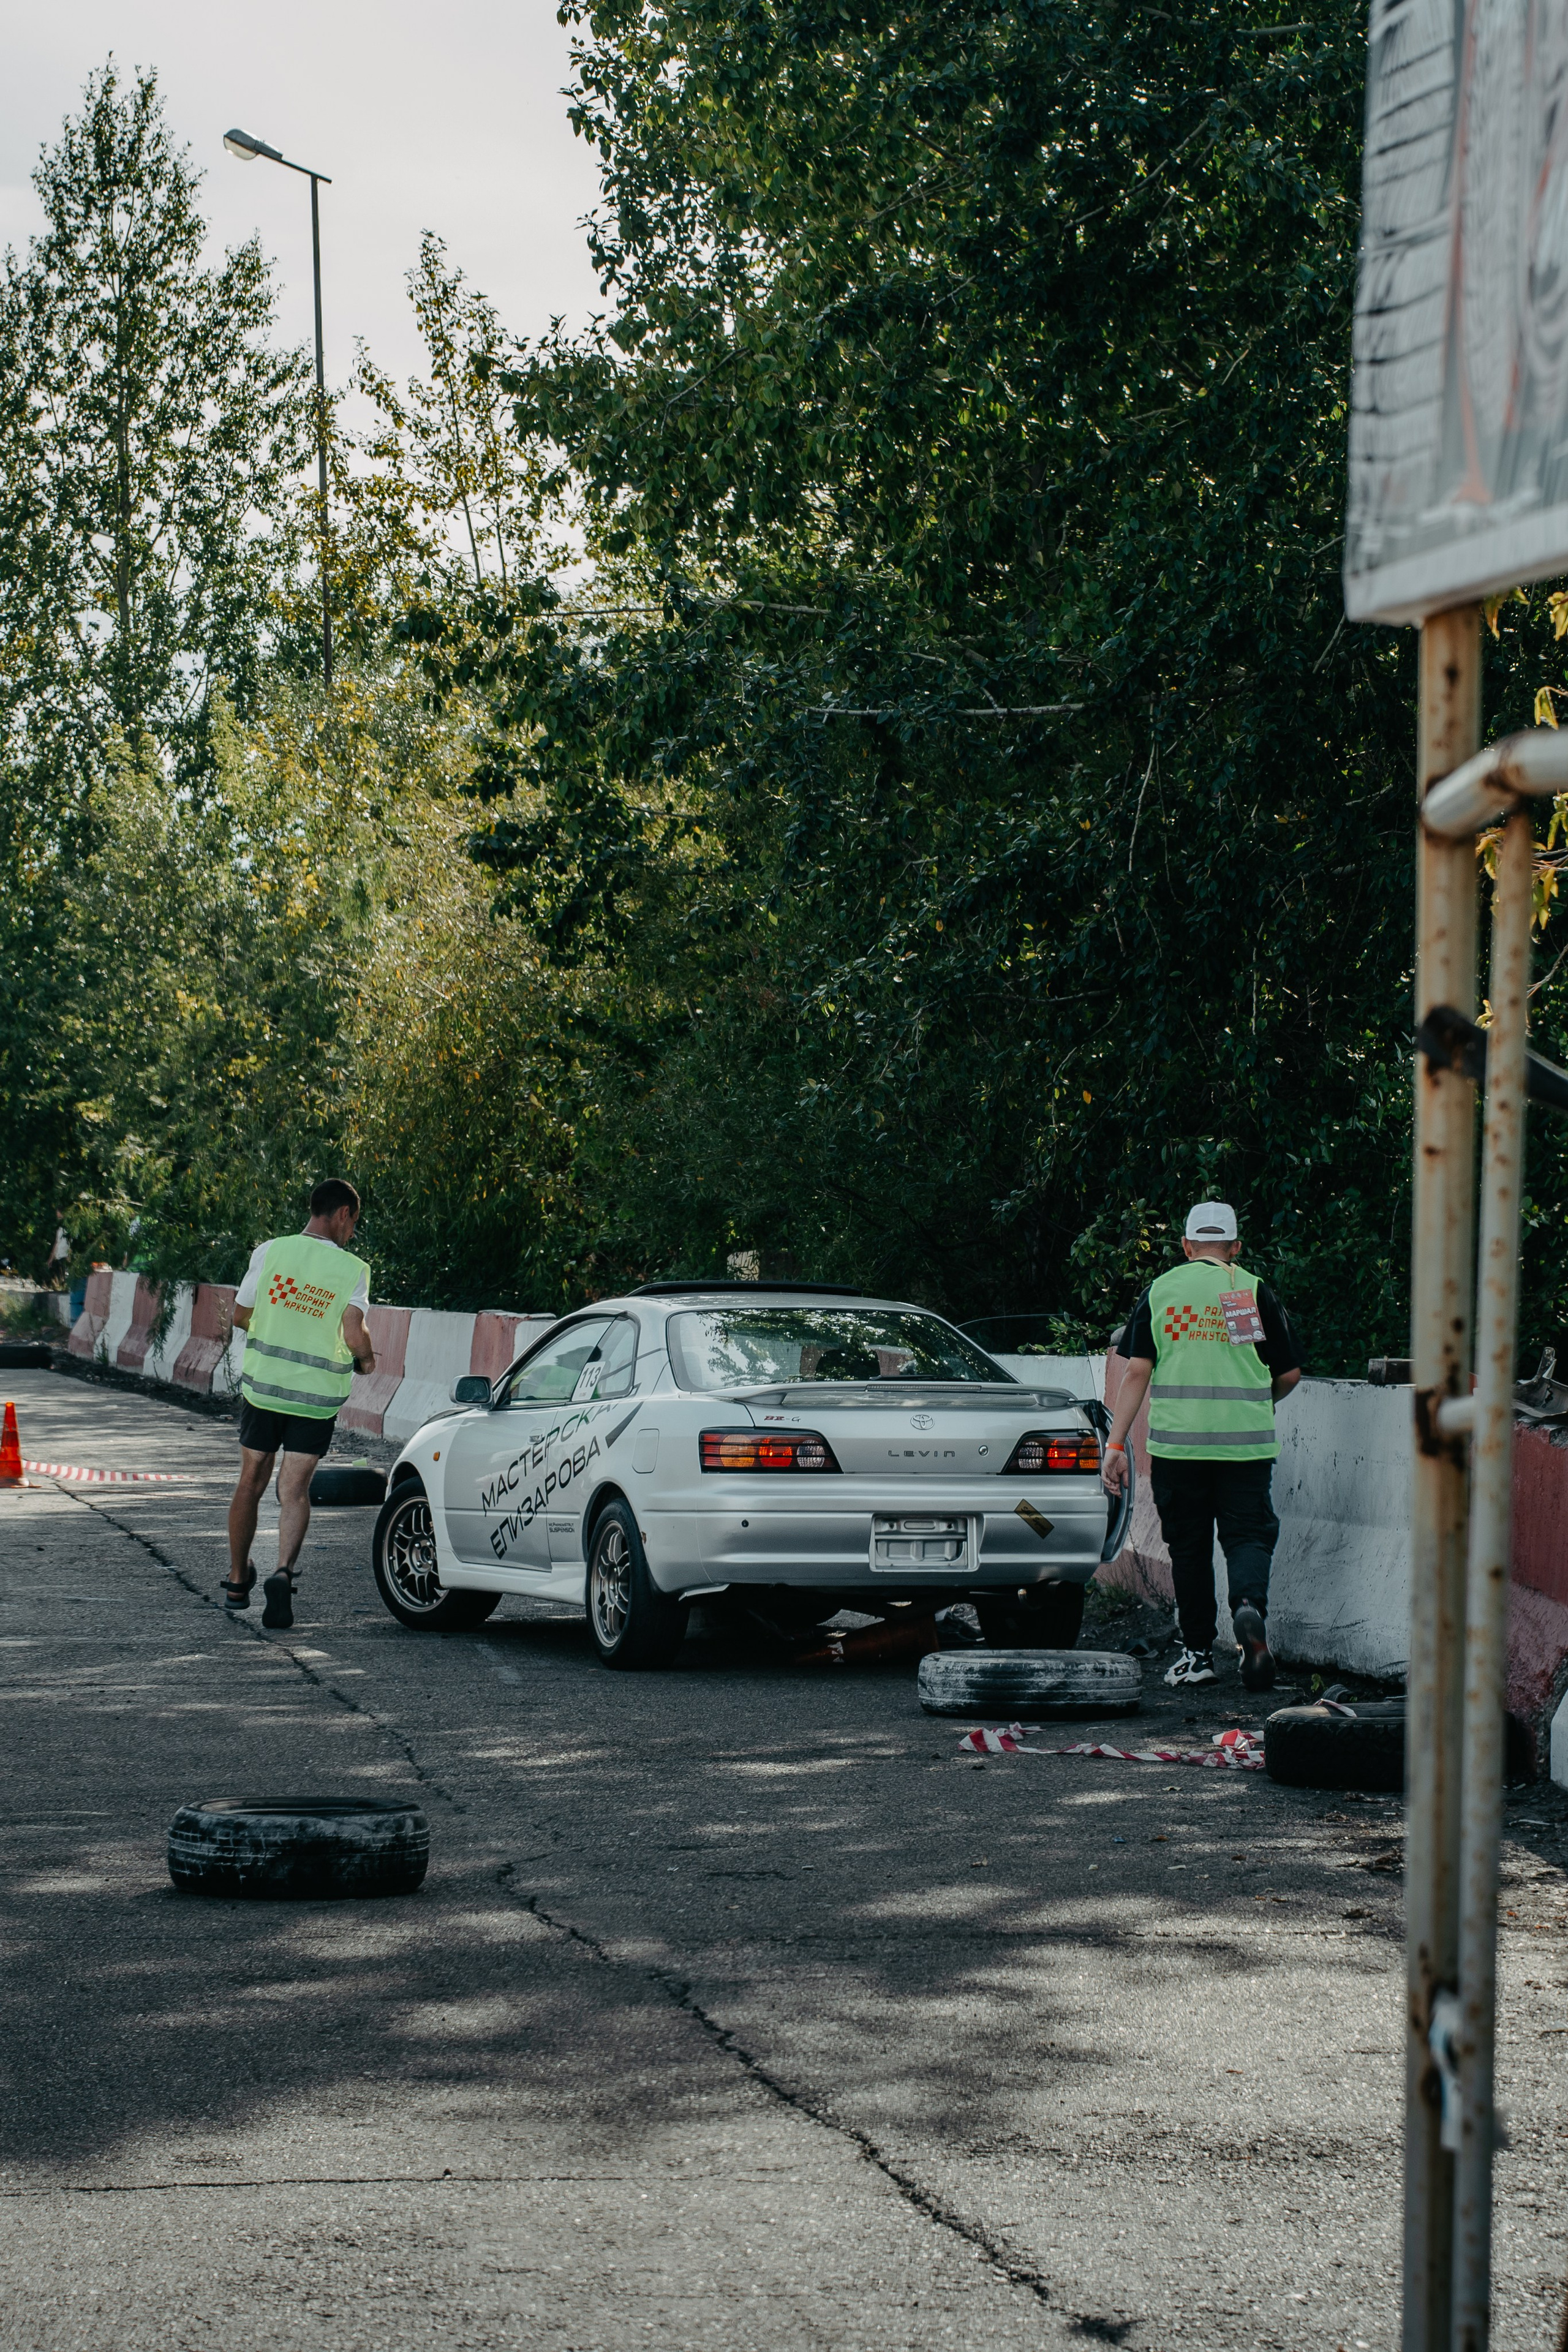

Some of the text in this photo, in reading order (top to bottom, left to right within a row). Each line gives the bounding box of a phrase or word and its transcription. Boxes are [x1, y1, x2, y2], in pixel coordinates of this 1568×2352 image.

[295, 1292, 331, 1310] СПРИНТ
[303, 1284, 336, 1301] РАЛЛИ
[284, 1300, 325, 1319] ИРКУТСК
[1225, 1306, 1257, 1319] МАРШАЛ
[579, 1366, 601, 1389] 113
